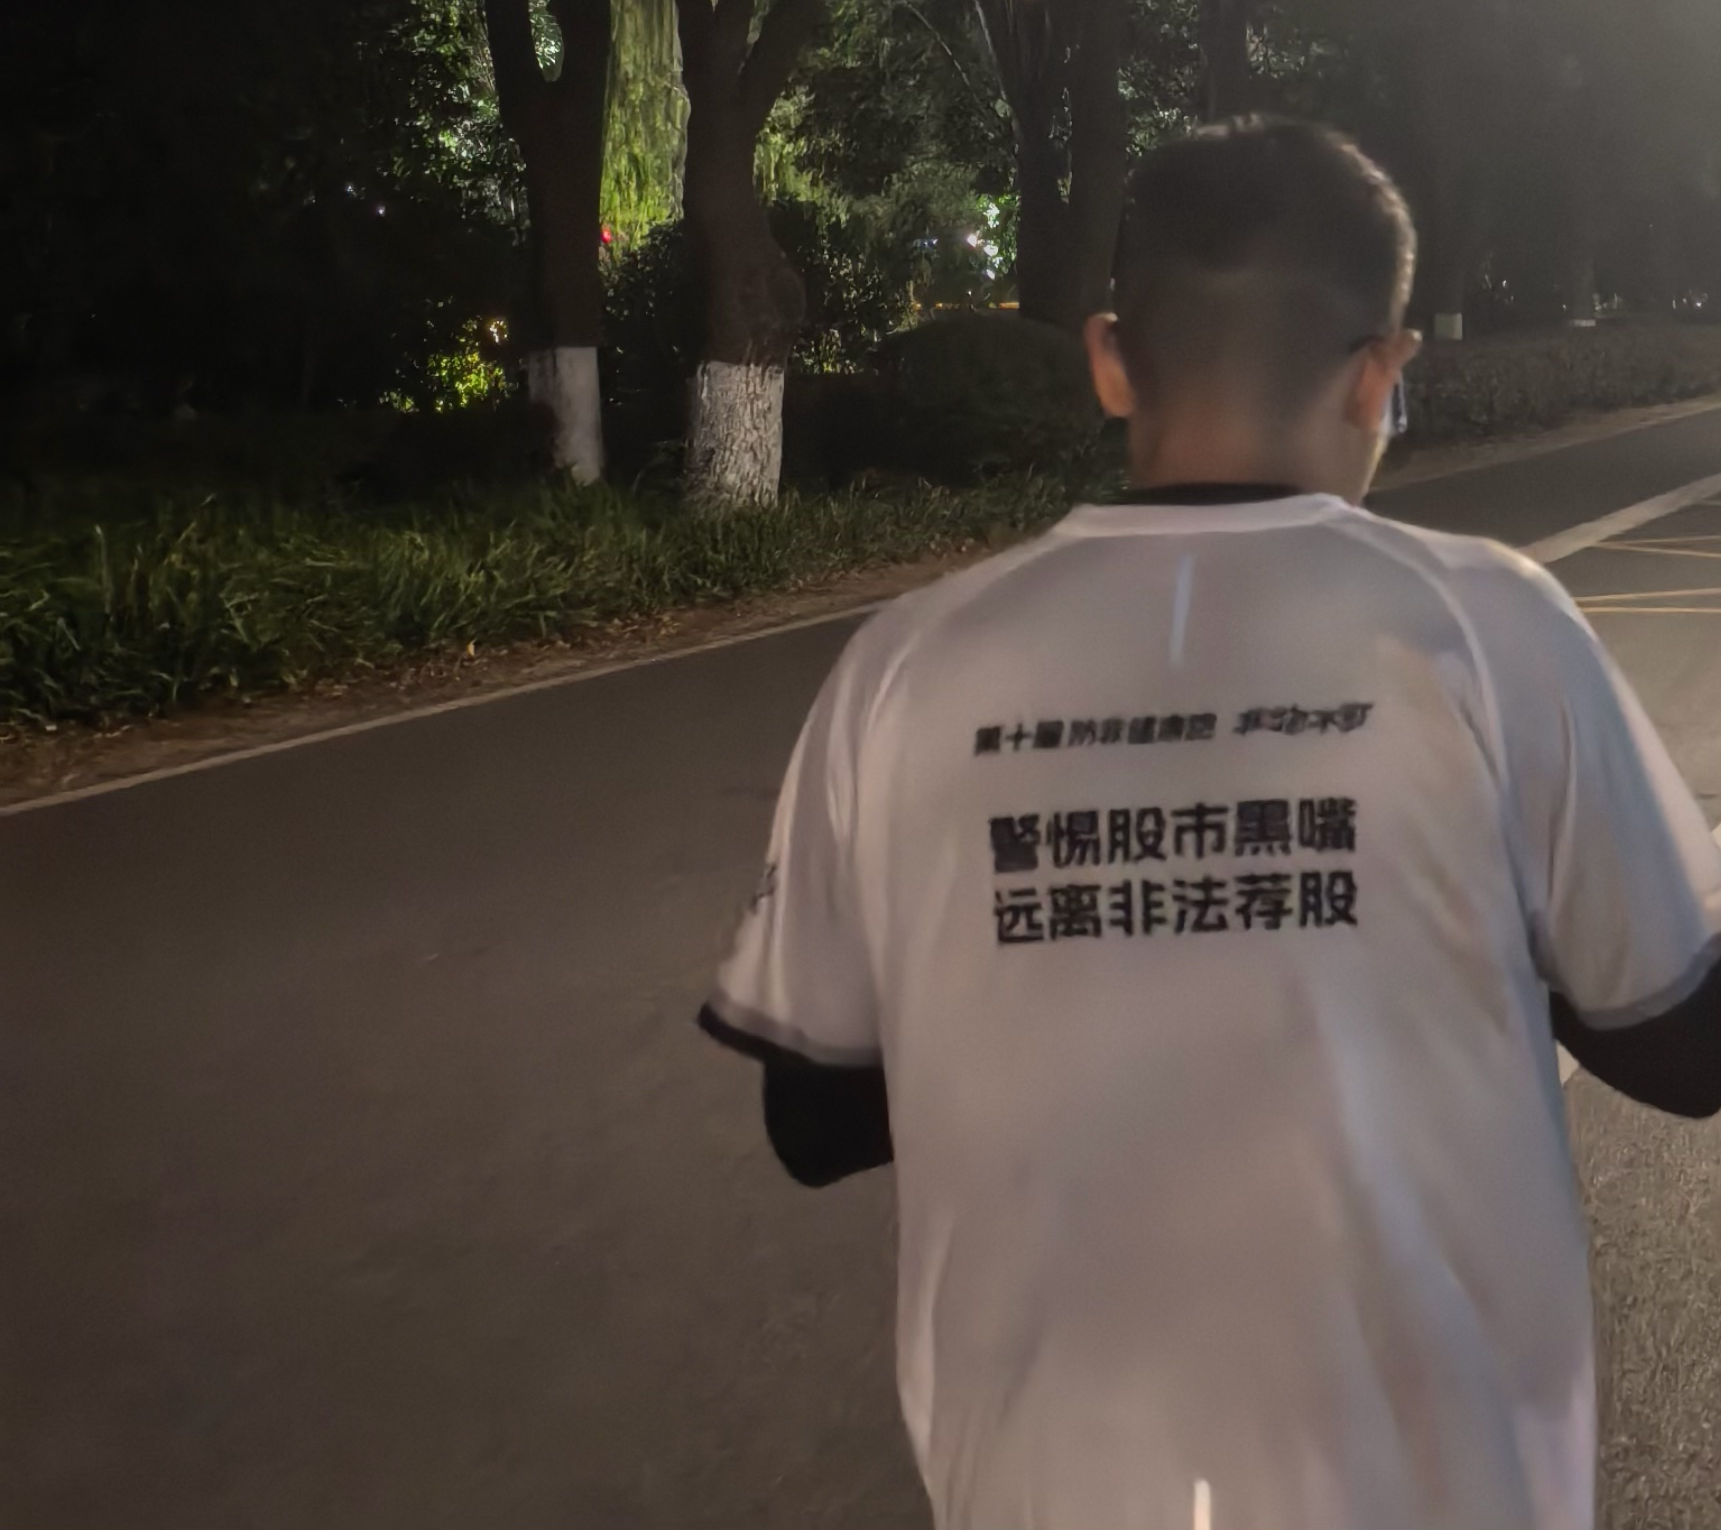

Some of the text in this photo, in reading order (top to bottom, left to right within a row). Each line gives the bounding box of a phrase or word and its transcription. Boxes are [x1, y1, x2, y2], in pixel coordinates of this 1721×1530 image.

[988, 796, 1358, 875] 警惕股市黑嘴
[995, 869, 1358, 947] 远离非法荐股
